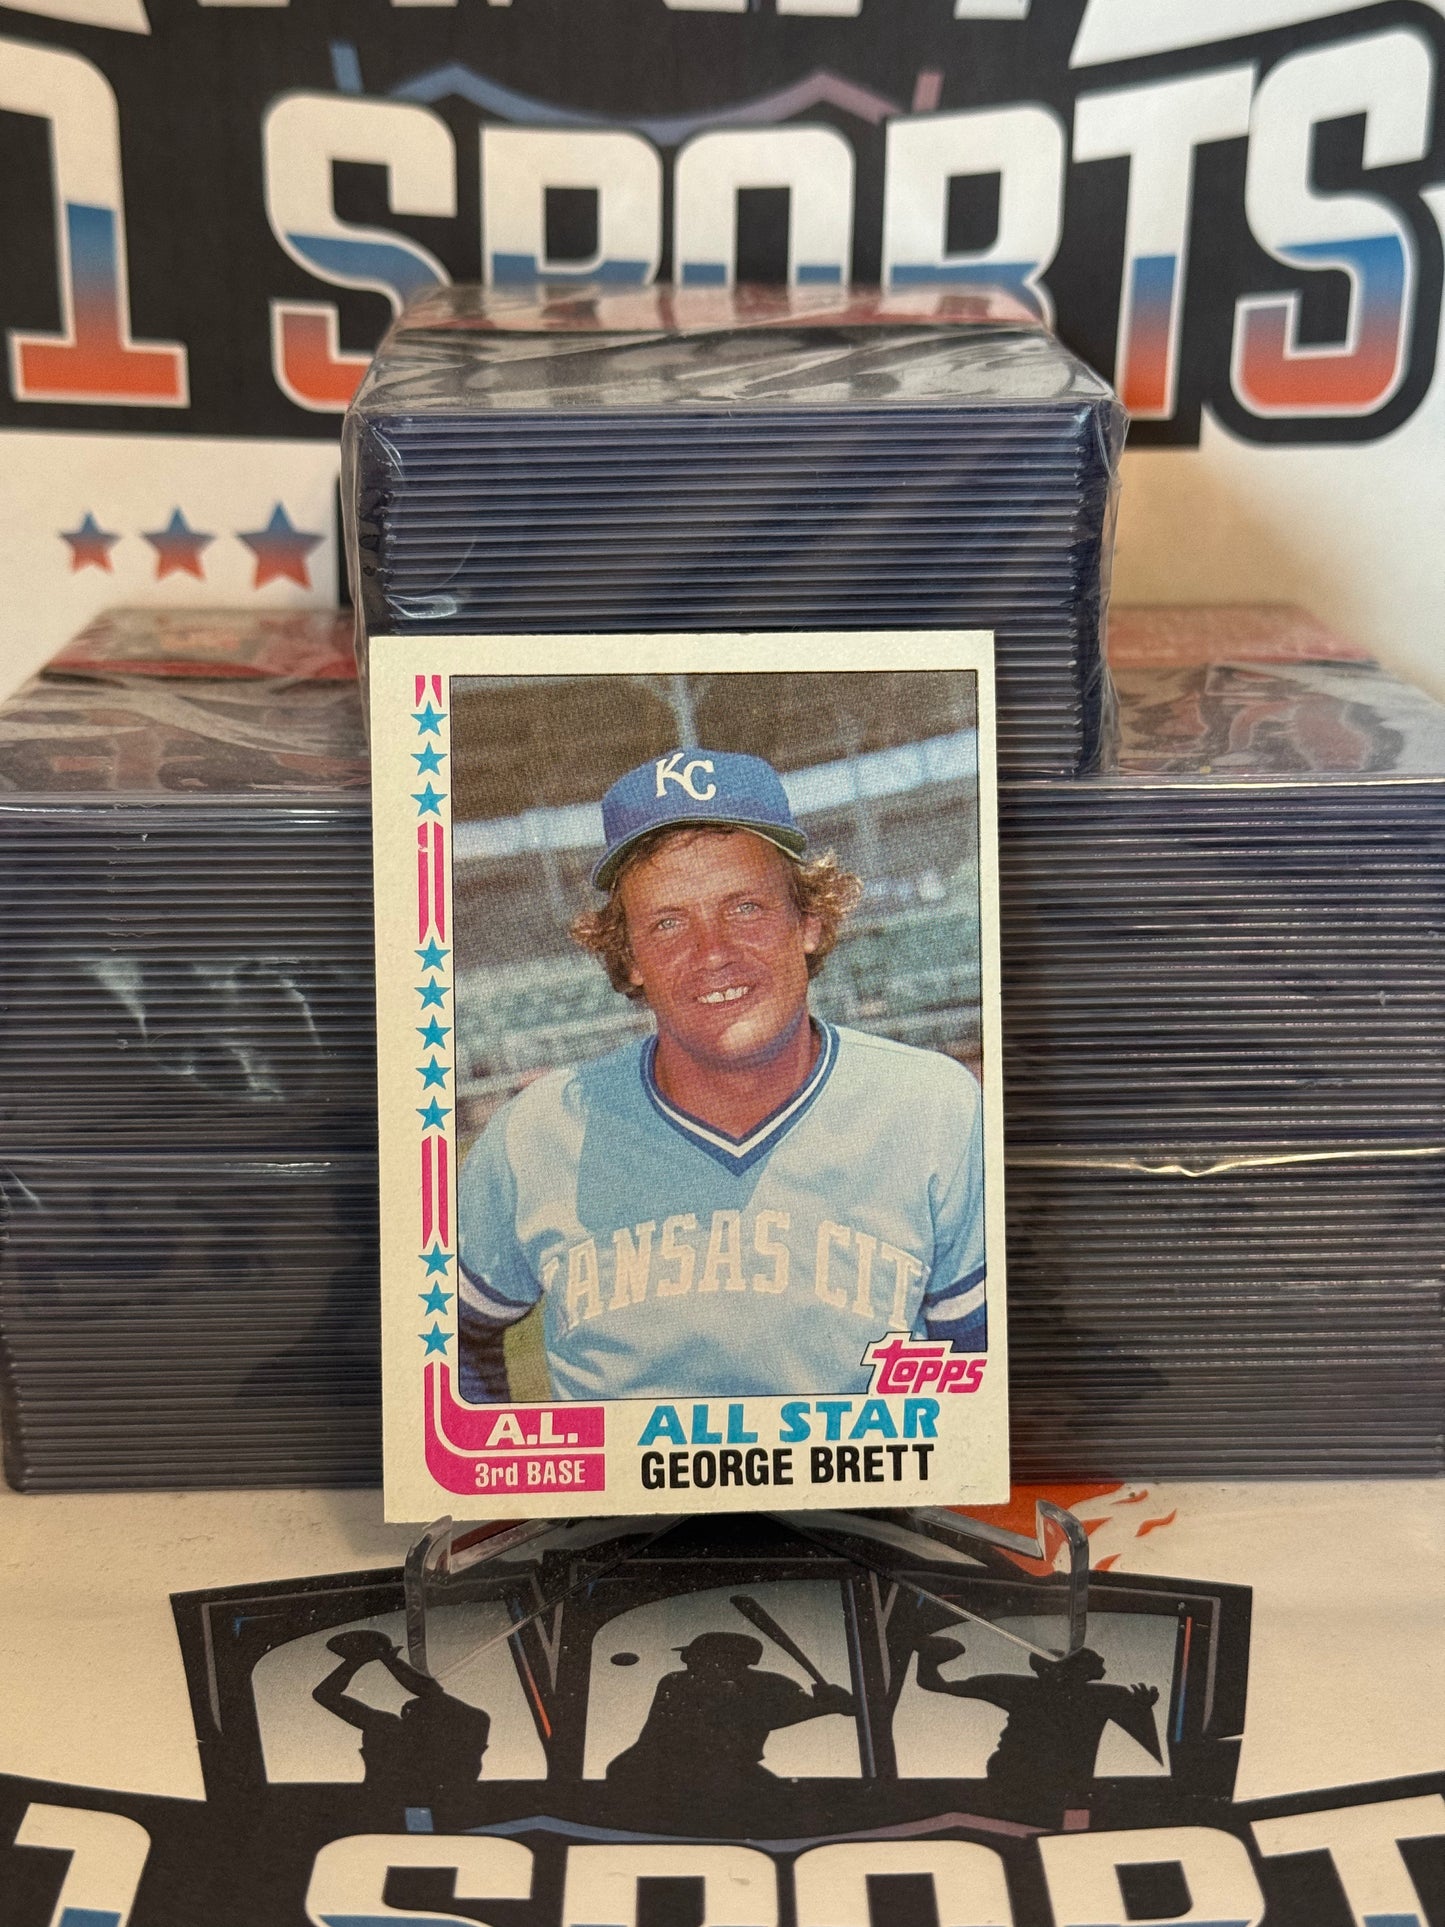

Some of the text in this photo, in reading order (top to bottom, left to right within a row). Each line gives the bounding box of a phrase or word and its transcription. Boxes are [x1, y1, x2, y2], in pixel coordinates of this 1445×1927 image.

[0, 26, 1434, 420] 1 SPORTS
[655, 752, 717, 801] KC
[814, 1219, 931, 1332] CIT
[485, 1411, 580, 1447] A.L.
[637, 1397, 941, 1446] ALL STAR
[474, 1459, 586, 1488] 3rd BASE
[640, 1443, 935, 1490] GEORGE BRETT
